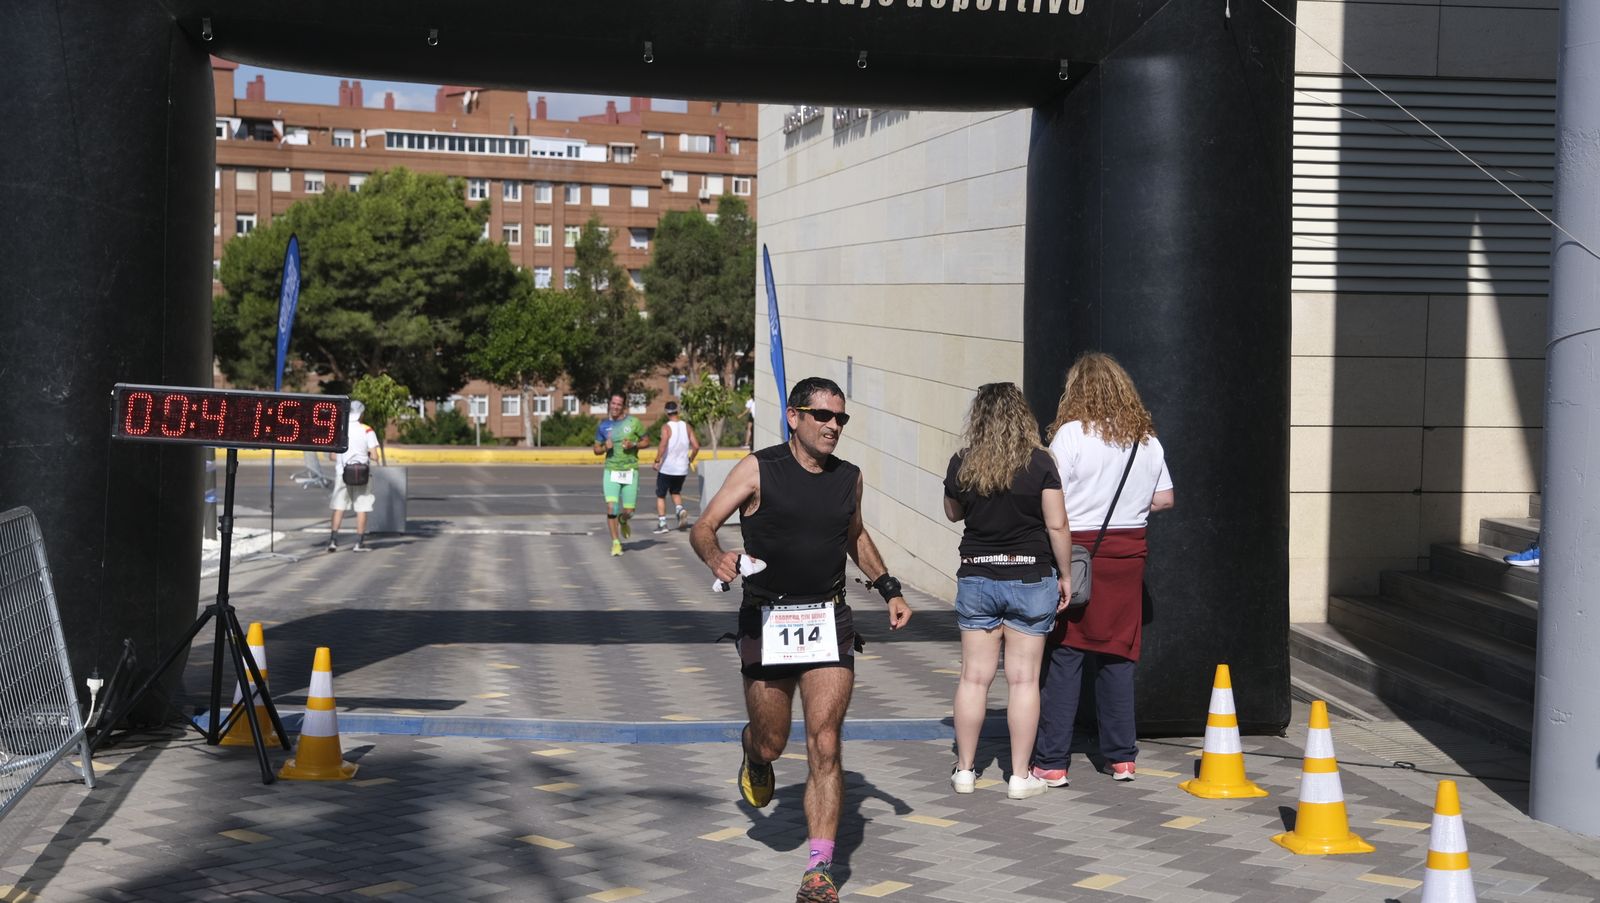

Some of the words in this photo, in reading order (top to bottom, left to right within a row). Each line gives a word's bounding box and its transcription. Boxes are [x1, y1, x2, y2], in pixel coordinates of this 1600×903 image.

[906, 0, 1086, 15] portivo
[125, 392, 338, 444] 00:41:59
[779, 626, 822, 646] 114
